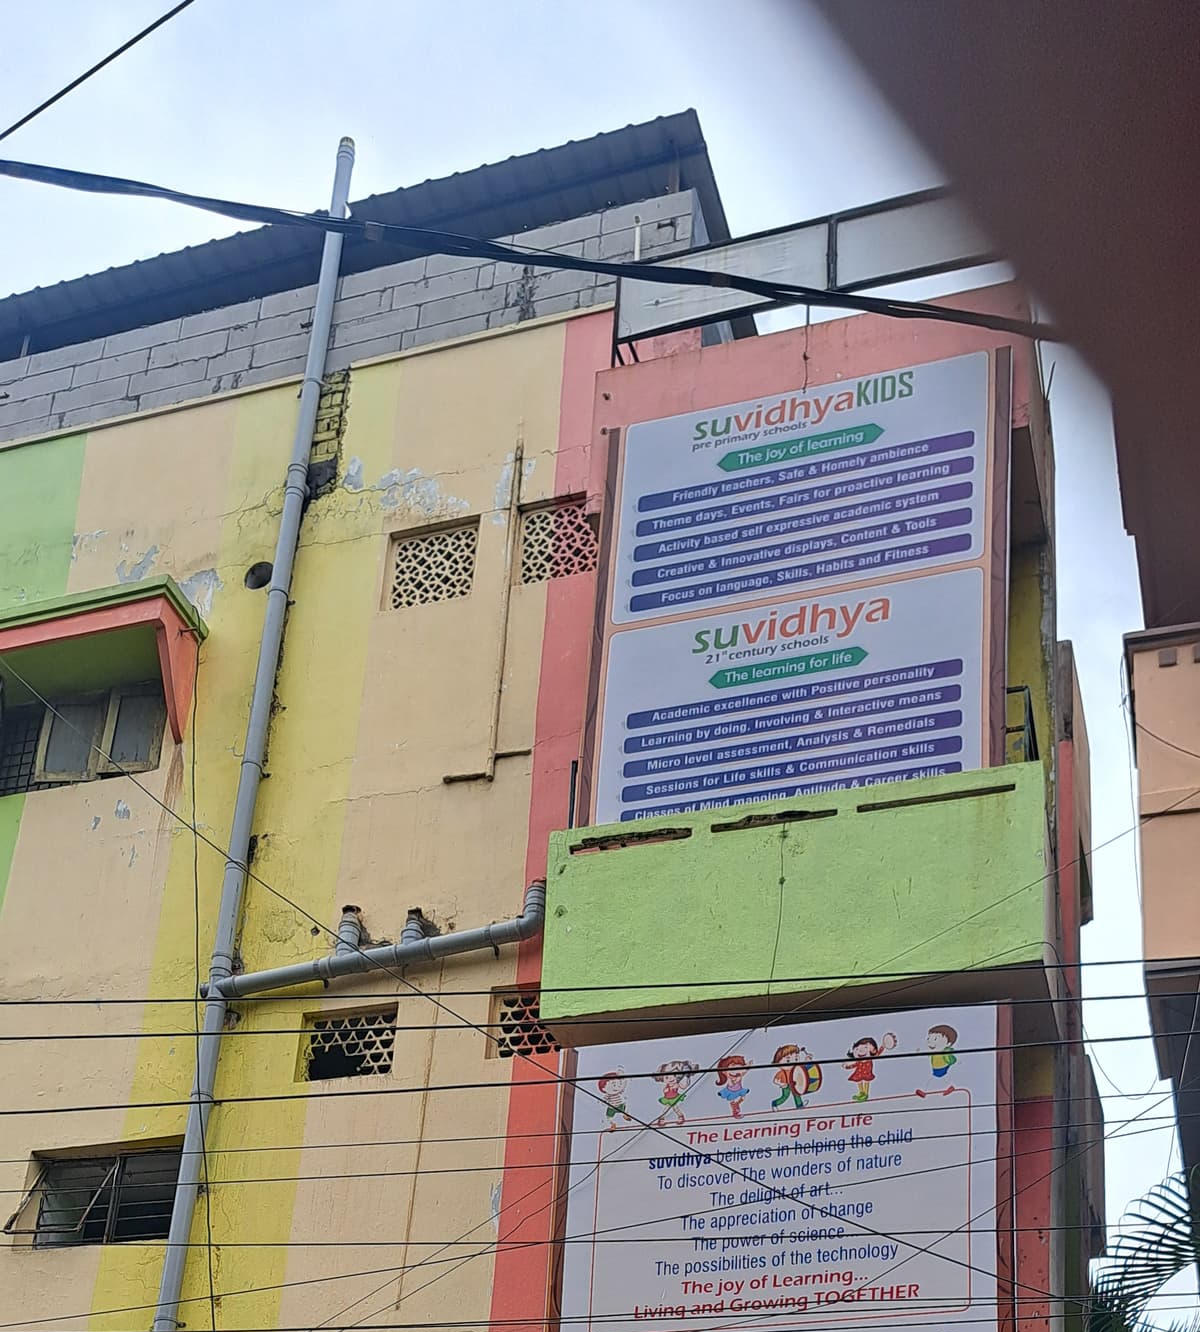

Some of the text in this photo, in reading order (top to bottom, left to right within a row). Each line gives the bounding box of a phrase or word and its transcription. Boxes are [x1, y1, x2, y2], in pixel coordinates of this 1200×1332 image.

[692, 371, 914, 441] suvidhyaKIDS
[692, 421, 807, 453] pre primary schools
[738, 431, 865, 465] The joy of learning
[672, 443, 929, 502] Friendly teachers, Safe Homely ambience
[652, 463, 950, 531] Theme days, Events, Fairs for proactive learning
[658, 491, 940, 554] Activity based self expressive academic system
[657, 517, 937, 579] Creative Innovative displays, Content Tools
[661, 545, 930, 602] Focus on language, Skills, Habits and Fitness
[692, 598, 891, 655] suvidhya
[729, 635, 830, 661] century schools
[724, 652, 852, 684] The learning for life
[652, 666, 935, 722] Academic excellence with Positive personality
[641, 691, 942, 748] Learning by Involving Interactive means
[647, 717, 936, 771] Micro level Analysis Remedials
[646, 743, 936, 796] Sessions for Life skills Communication skills
[687, 1113, 873, 1145] The Learning For Life
[716, 1128, 913, 1164] believes helping child
[657, 1153, 902, 1190] To discover The wonders of nature
[710, 1186, 787, 1207] The delight
[680, 1201, 873, 1231] The appreciation of change
[655, 1243, 899, 1277] The possibilities of the technology
[722, 1236, 766, 1252] power
[681, 1275, 768, 1297] The joy of
[730, 1283, 920, 1312] Growing TOGETHER
